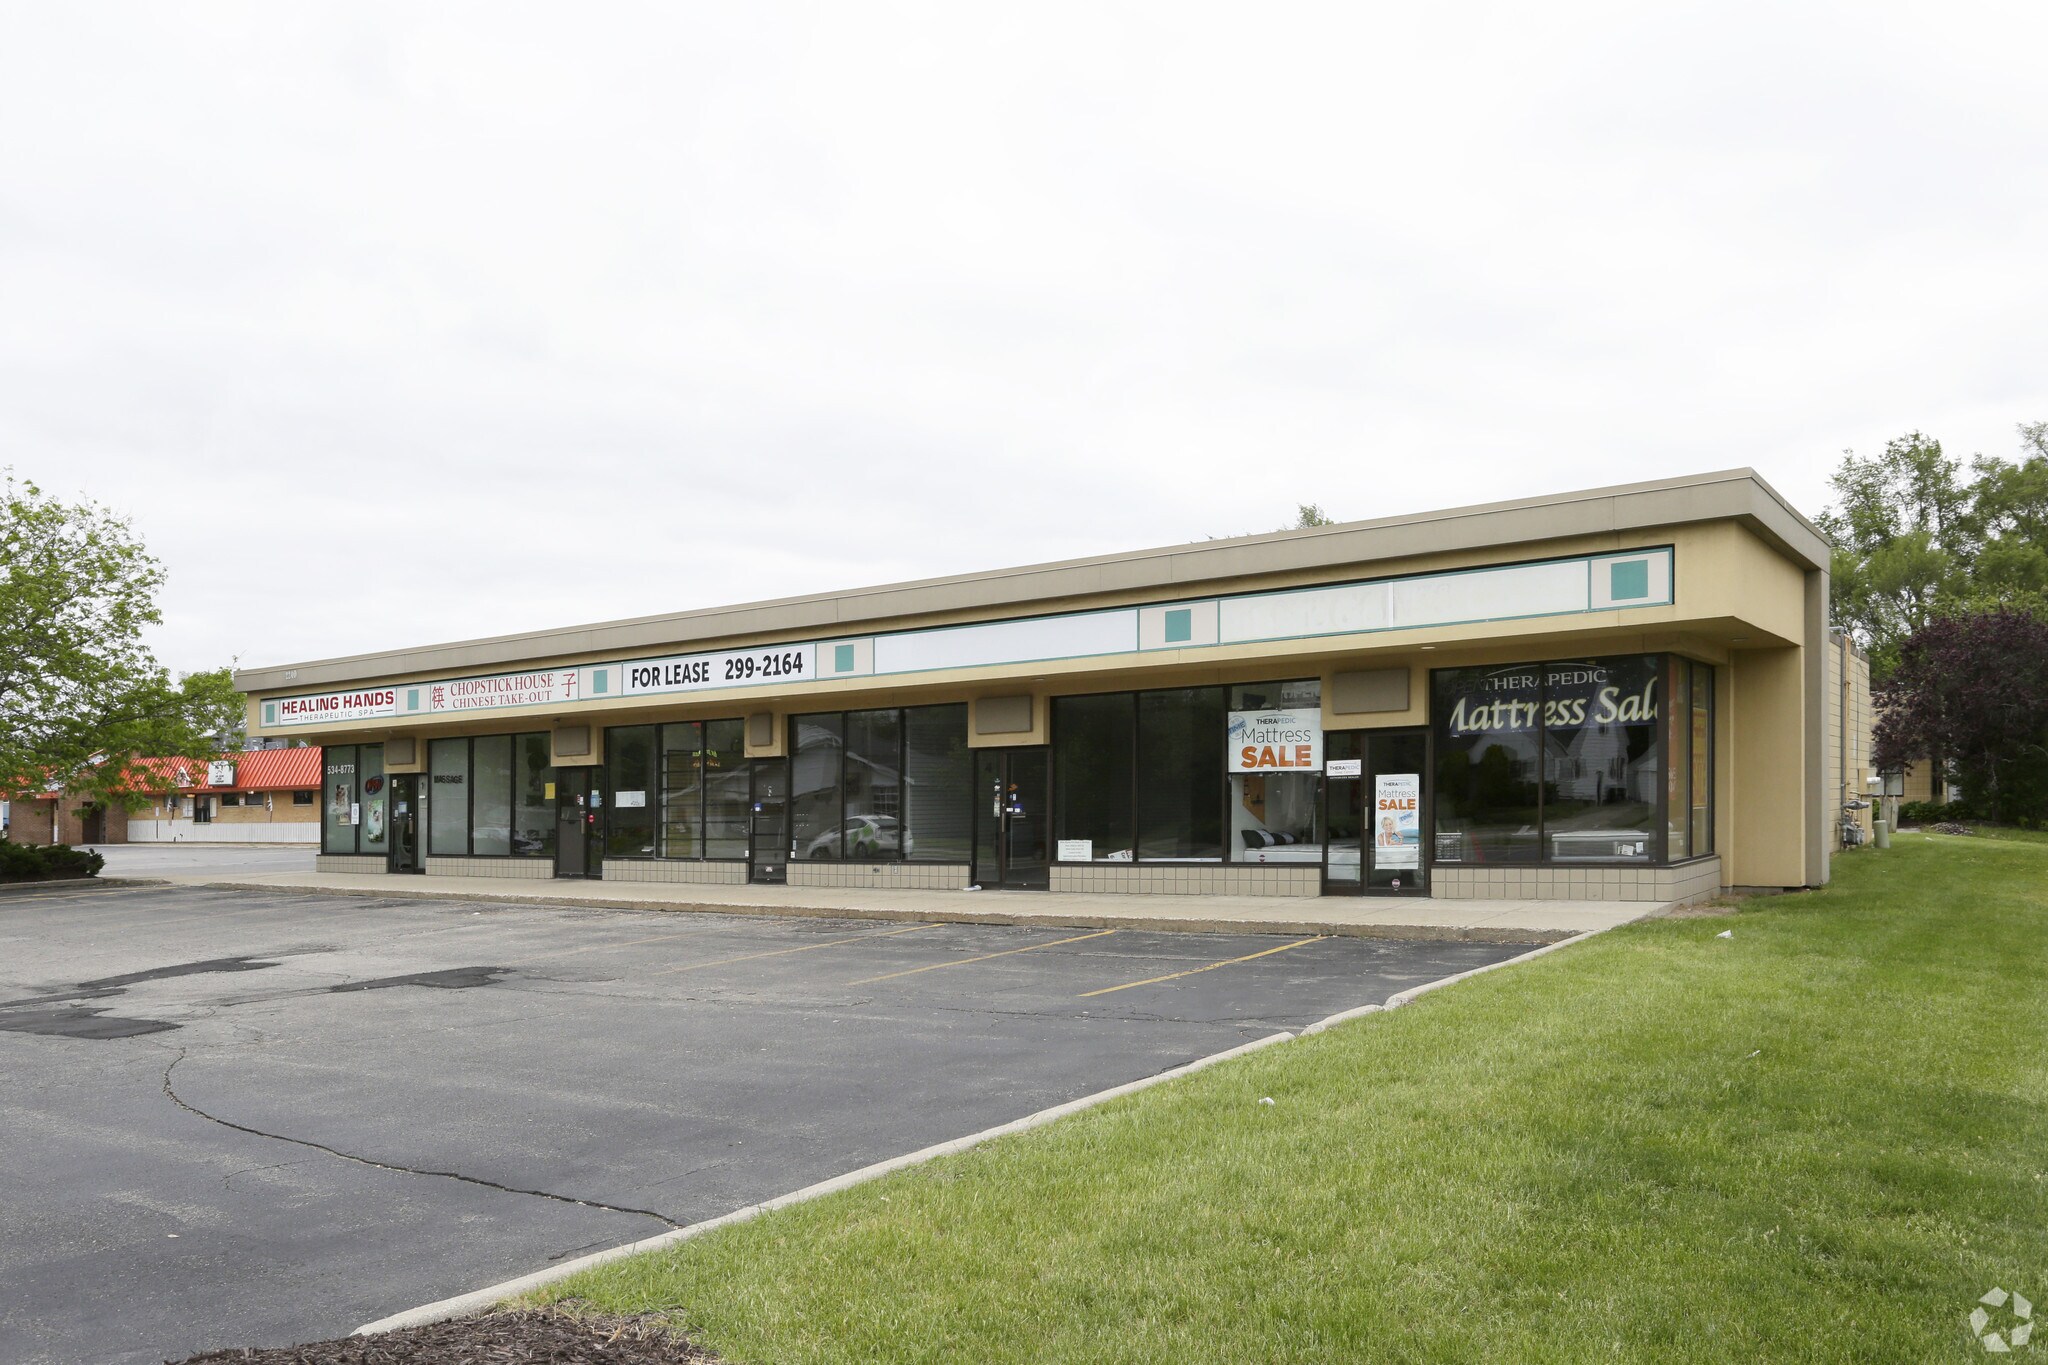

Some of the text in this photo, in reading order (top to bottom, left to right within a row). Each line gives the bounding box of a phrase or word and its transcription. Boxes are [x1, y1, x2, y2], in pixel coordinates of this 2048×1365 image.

[632, 652, 804, 689] FOR LEASE 299-2164
[1480, 669, 1607, 691] THERAPEDIC
[450, 673, 555, 697] CHOPSTICK HOUSE
[561, 672, 577, 698] 子
[282, 690, 395, 715] HEALING HANDS
[452, 690, 553, 709] CHINESE TAKE-OUT
[1595, 676, 1658, 724] Sal
[300, 708, 374, 721] THERAPEUTIC SPA
[1256, 717, 1297, 725] THERAPEDIC
[1241, 727, 1312, 744] Mattress
[1241, 744, 1312, 769] SALE
[327, 764, 355, 775] 534-8773
[433, 774, 464, 785] MASSAGE
[1378, 789, 1416, 798] Mattress
[1378, 798, 1416, 811] SALE
